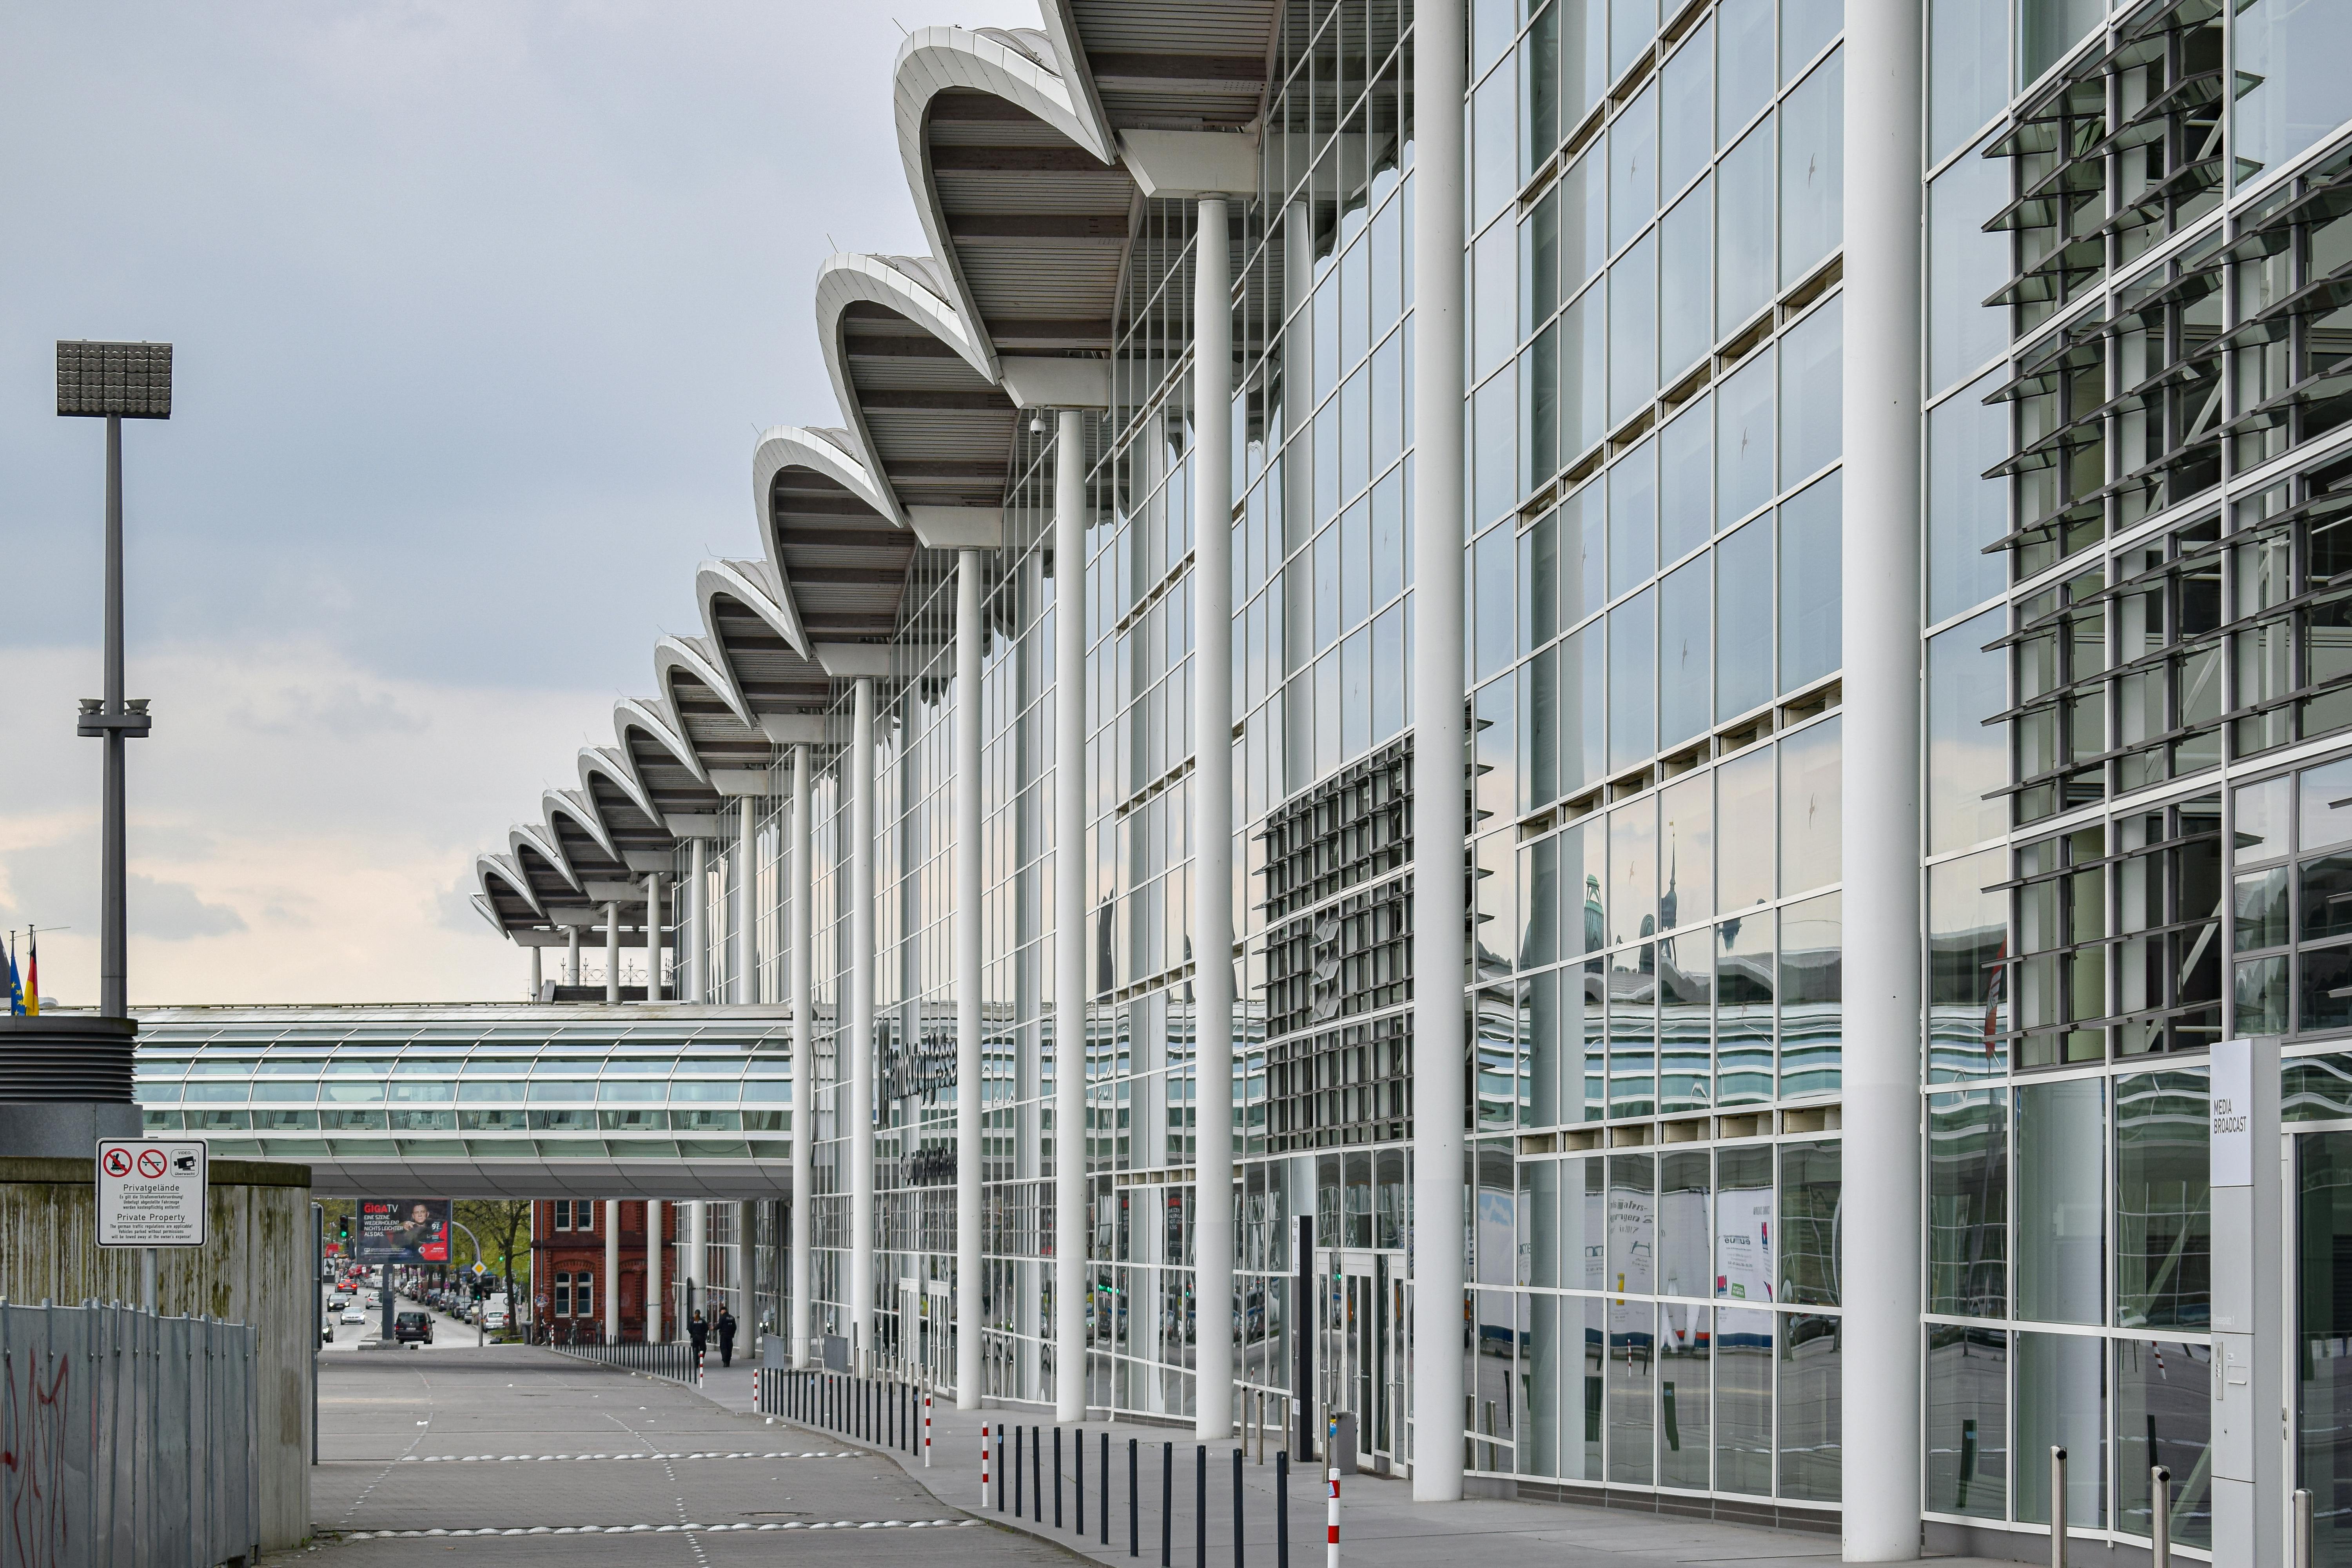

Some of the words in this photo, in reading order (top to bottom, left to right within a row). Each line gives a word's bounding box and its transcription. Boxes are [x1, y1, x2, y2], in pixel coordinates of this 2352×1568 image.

[2214, 1099, 2232, 1116] MEDIA
[2214, 1116, 2247, 1134] BROADCAST
[123, 1184, 180, 1192] Privatgelände
[150, 1214, 185, 1222] Property
